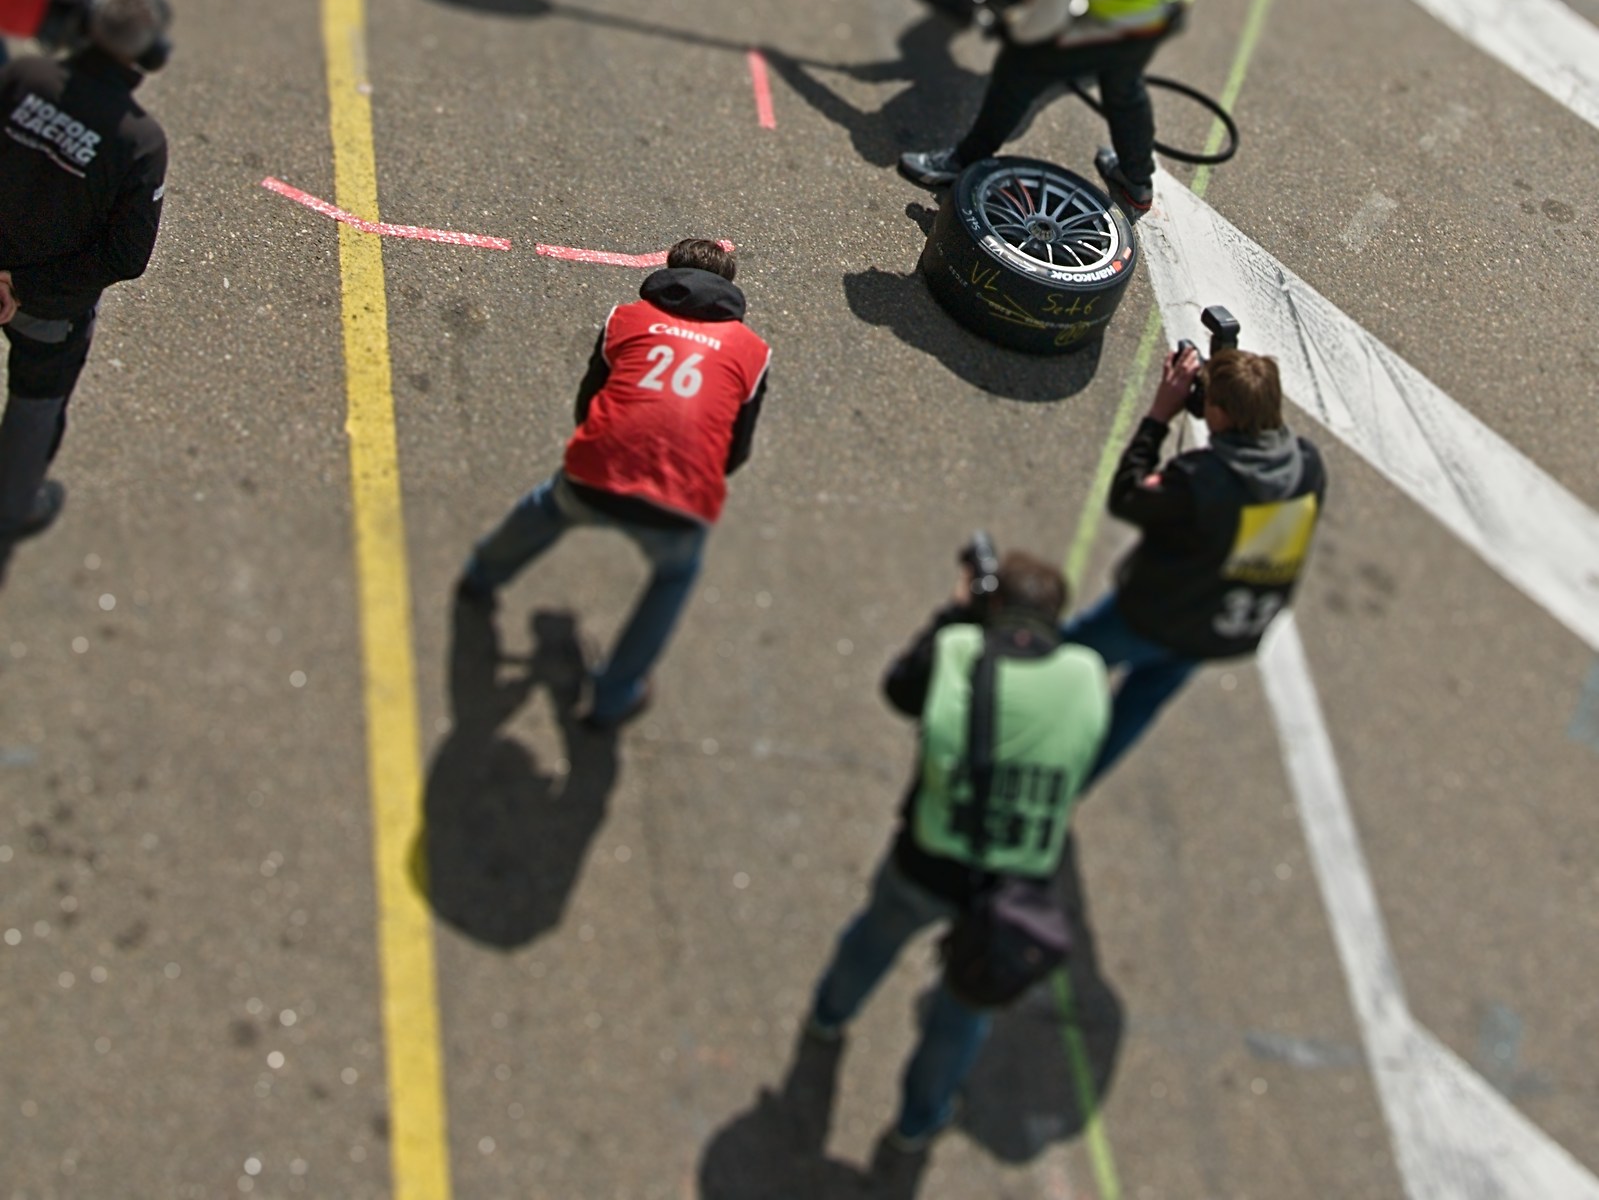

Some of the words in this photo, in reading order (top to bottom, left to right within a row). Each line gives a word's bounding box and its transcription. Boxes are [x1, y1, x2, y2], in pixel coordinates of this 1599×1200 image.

[11, 107, 96, 163] RACING
[22, 93, 101, 149] HOFOR
[648, 323, 721, 351] Canon
[637, 344, 704, 399] 26
